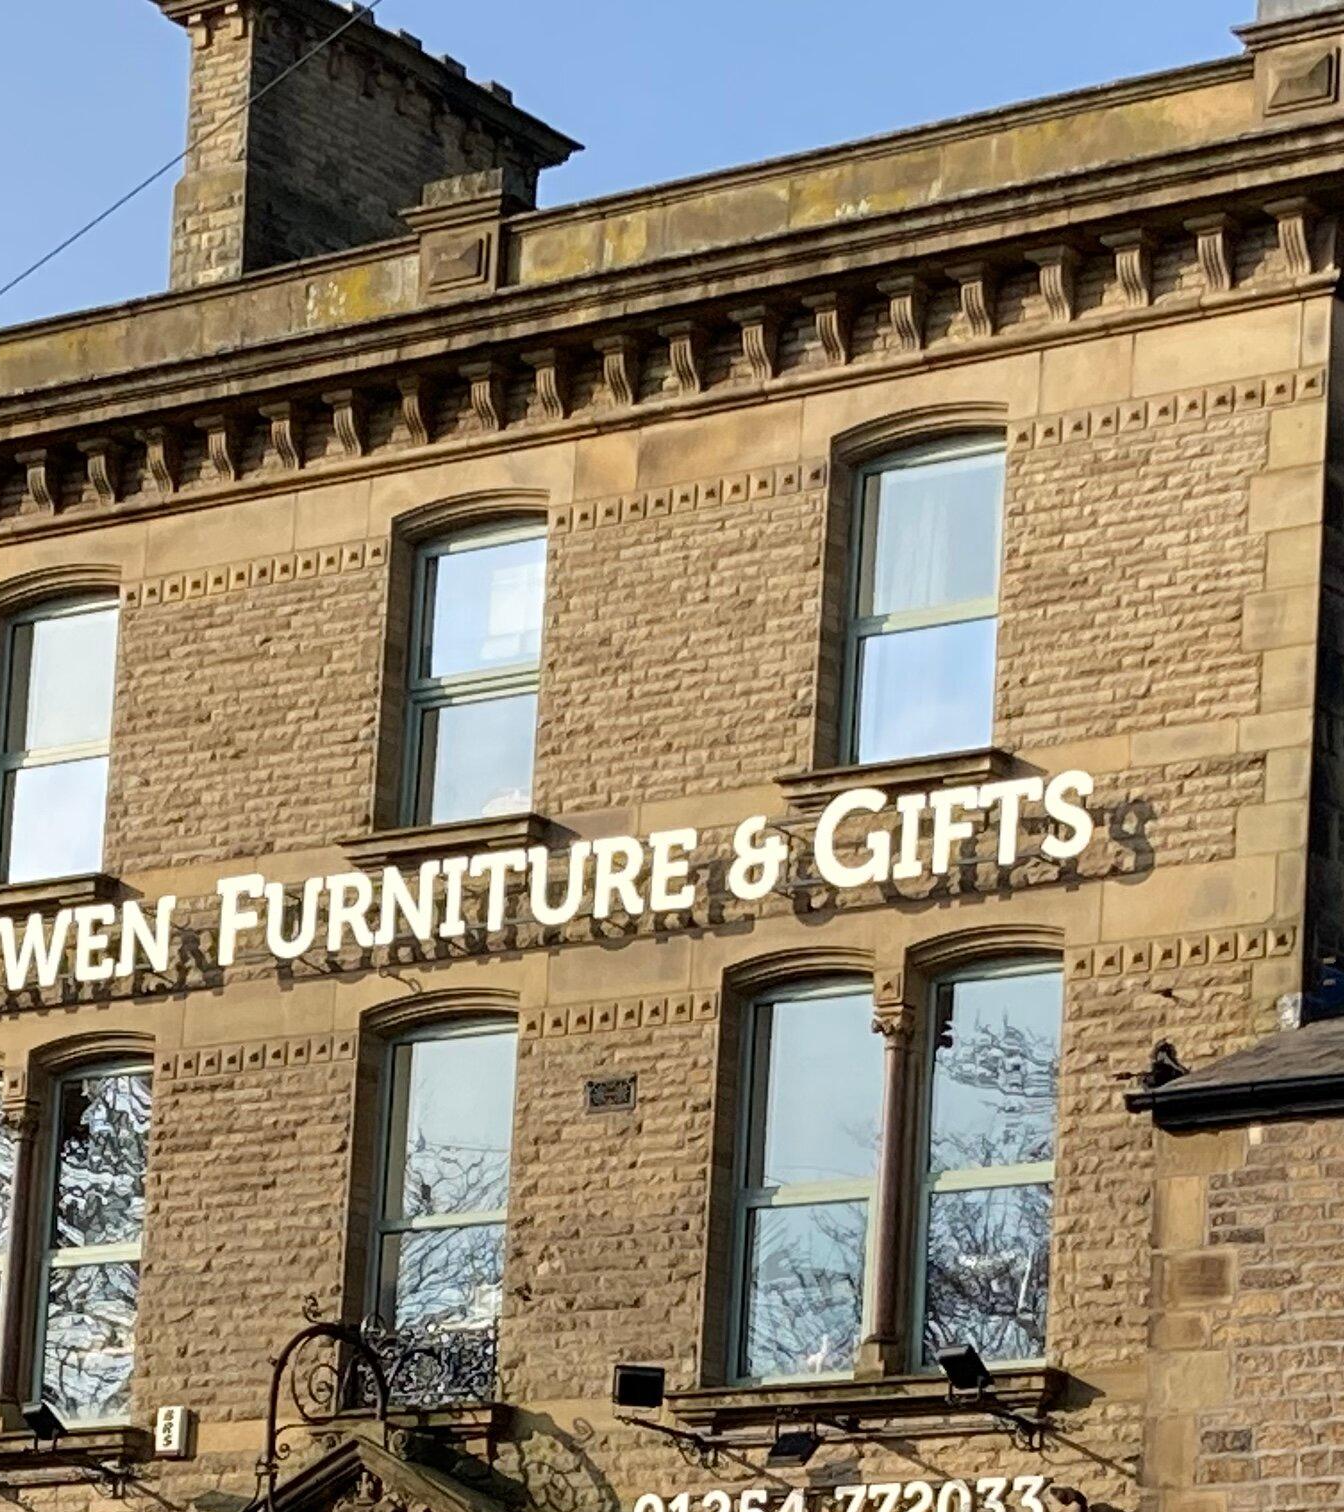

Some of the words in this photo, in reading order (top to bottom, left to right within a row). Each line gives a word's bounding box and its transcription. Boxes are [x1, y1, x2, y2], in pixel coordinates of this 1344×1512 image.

[216, 828, 698, 966] FURNITURE
[728, 815, 788, 901] &
[814, 769, 1095, 889] GIFTS
